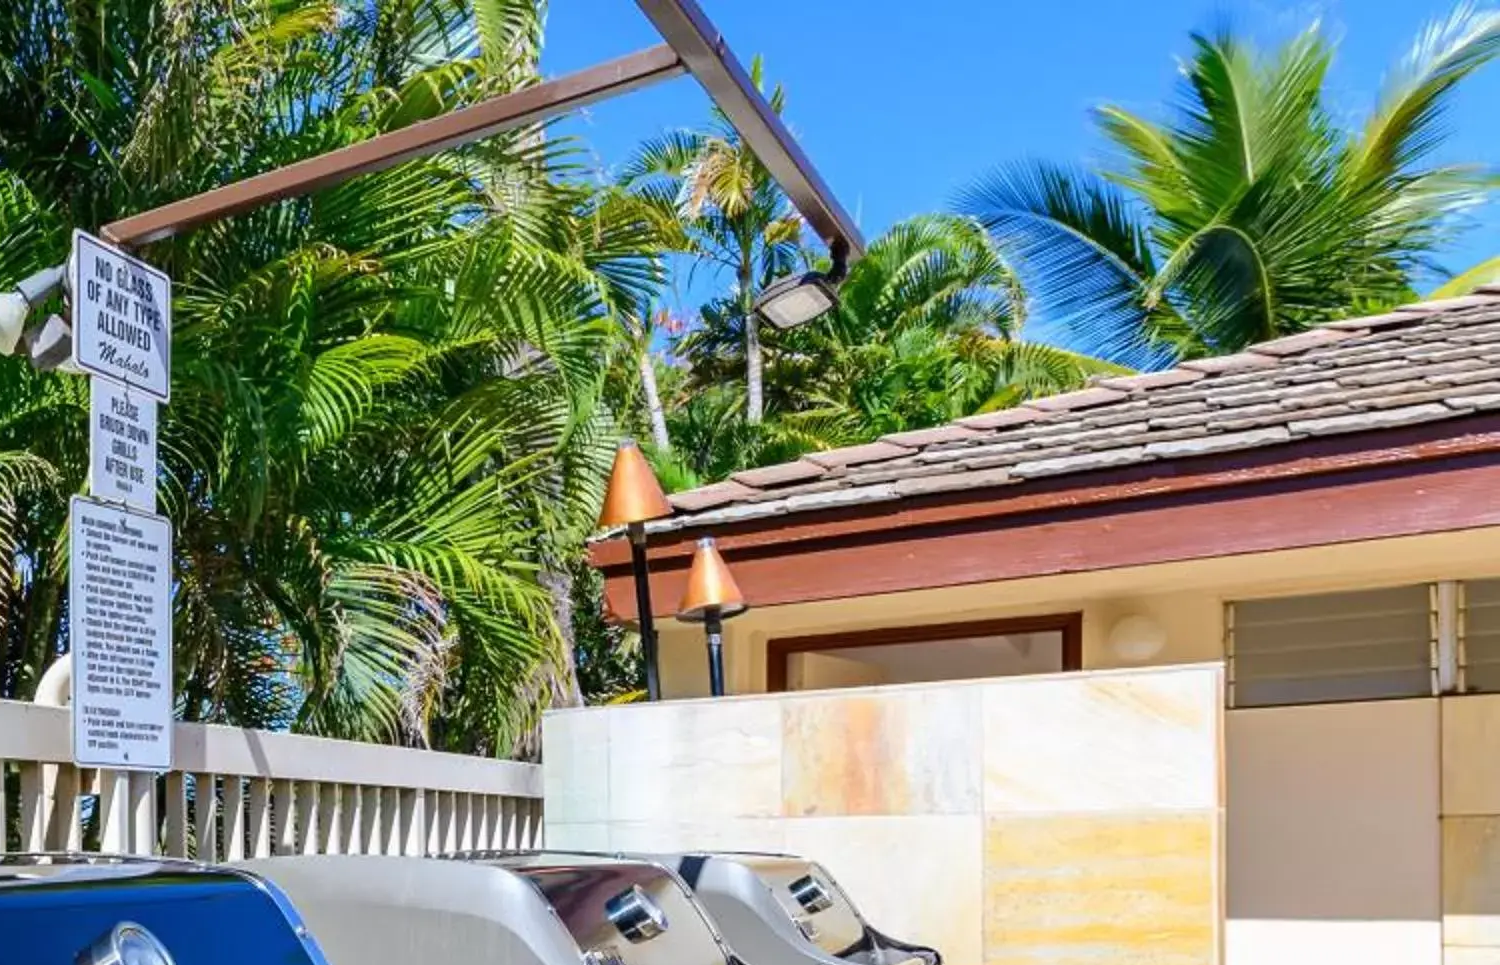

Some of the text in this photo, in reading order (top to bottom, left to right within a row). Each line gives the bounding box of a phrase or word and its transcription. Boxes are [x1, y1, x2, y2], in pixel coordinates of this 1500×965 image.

[95, 256, 153, 302] NO GLASS
[87, 280, 161, 331] OF ANY TYPE
[97, 312, 152, 352] ALLOWED
[98, 340, 150, 378] Mahalo
[111, 397, 139, 422] PLEASE
[105, 456, 145, 485] AFTER USE
